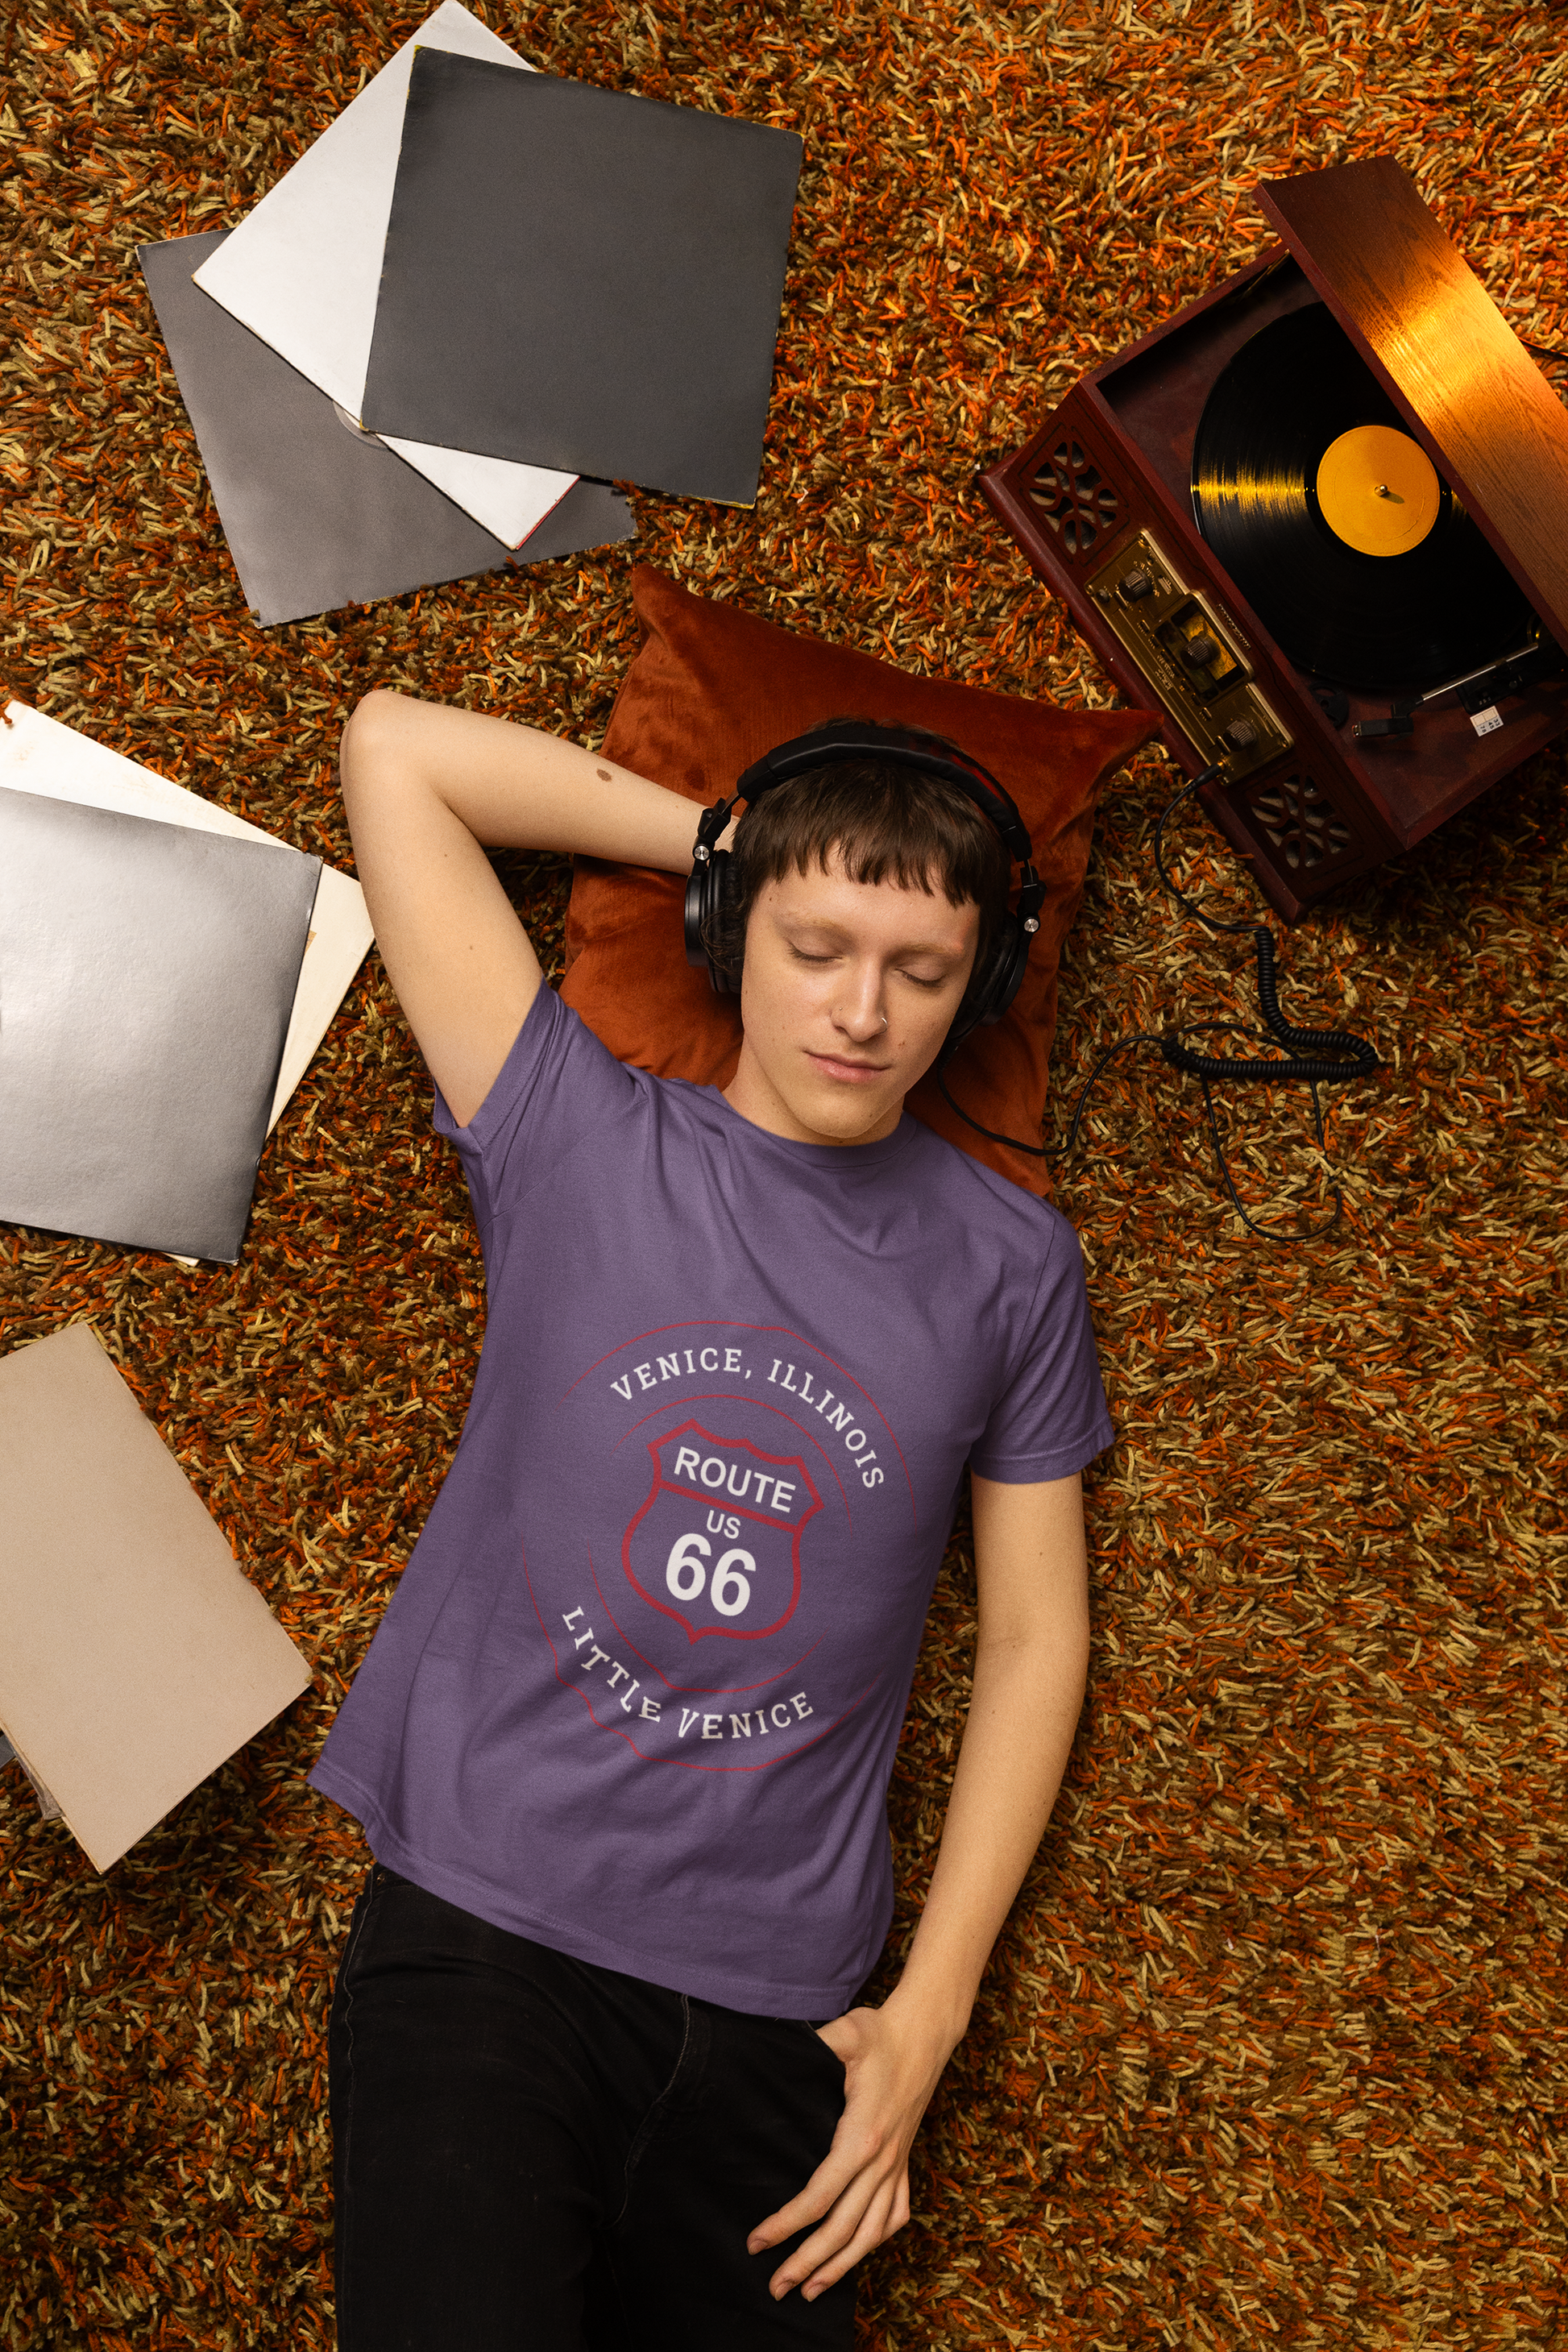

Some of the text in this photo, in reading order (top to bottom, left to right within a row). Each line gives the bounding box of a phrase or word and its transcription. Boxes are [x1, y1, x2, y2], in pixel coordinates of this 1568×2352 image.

[609, 1347, 884, 1488] VENICE, ILLINOIS
[674, 1446, 796, 1513] ROUTE
[706, 1509, 741, 1540] US
[666, 1533, 757, 1616] 66
[562, 1606, 814, 1740] LITTLE VENICE
